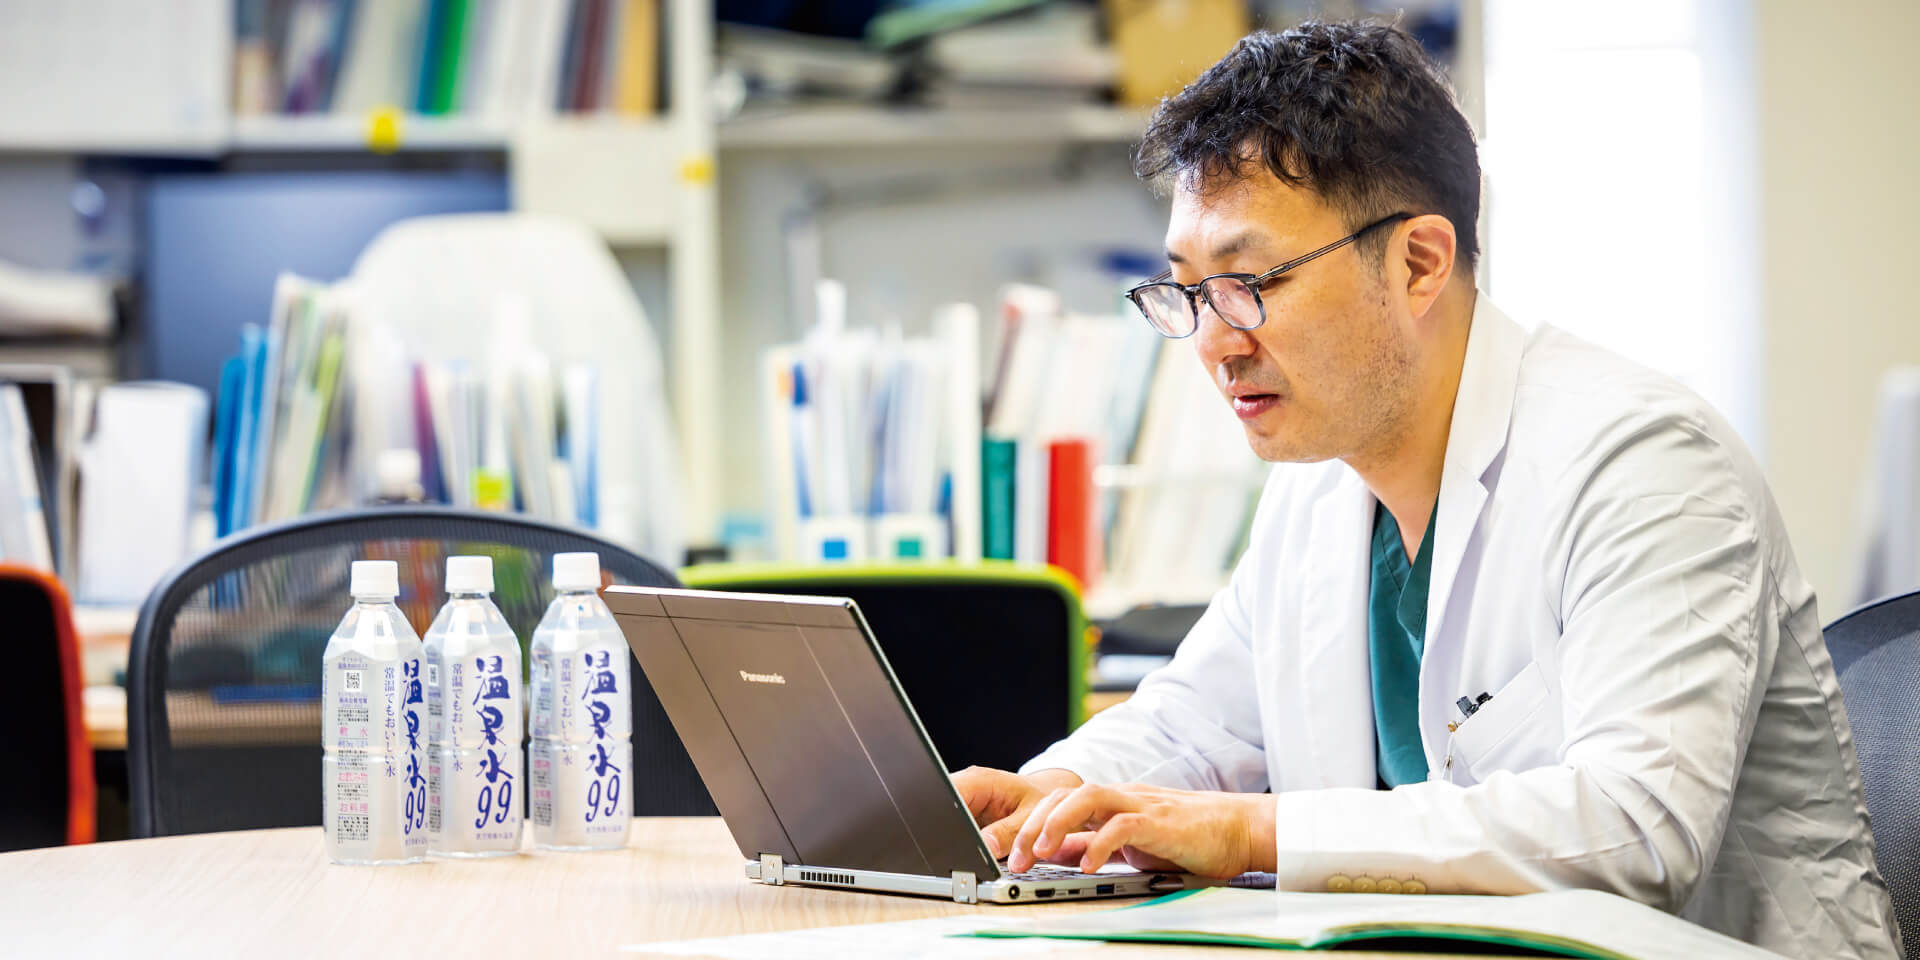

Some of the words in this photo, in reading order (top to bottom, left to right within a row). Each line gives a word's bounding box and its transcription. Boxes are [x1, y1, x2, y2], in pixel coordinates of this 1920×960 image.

[739, 670, 786, 684] Panasonic
[384, 665, 396, 777] 常温でもおいしい水
